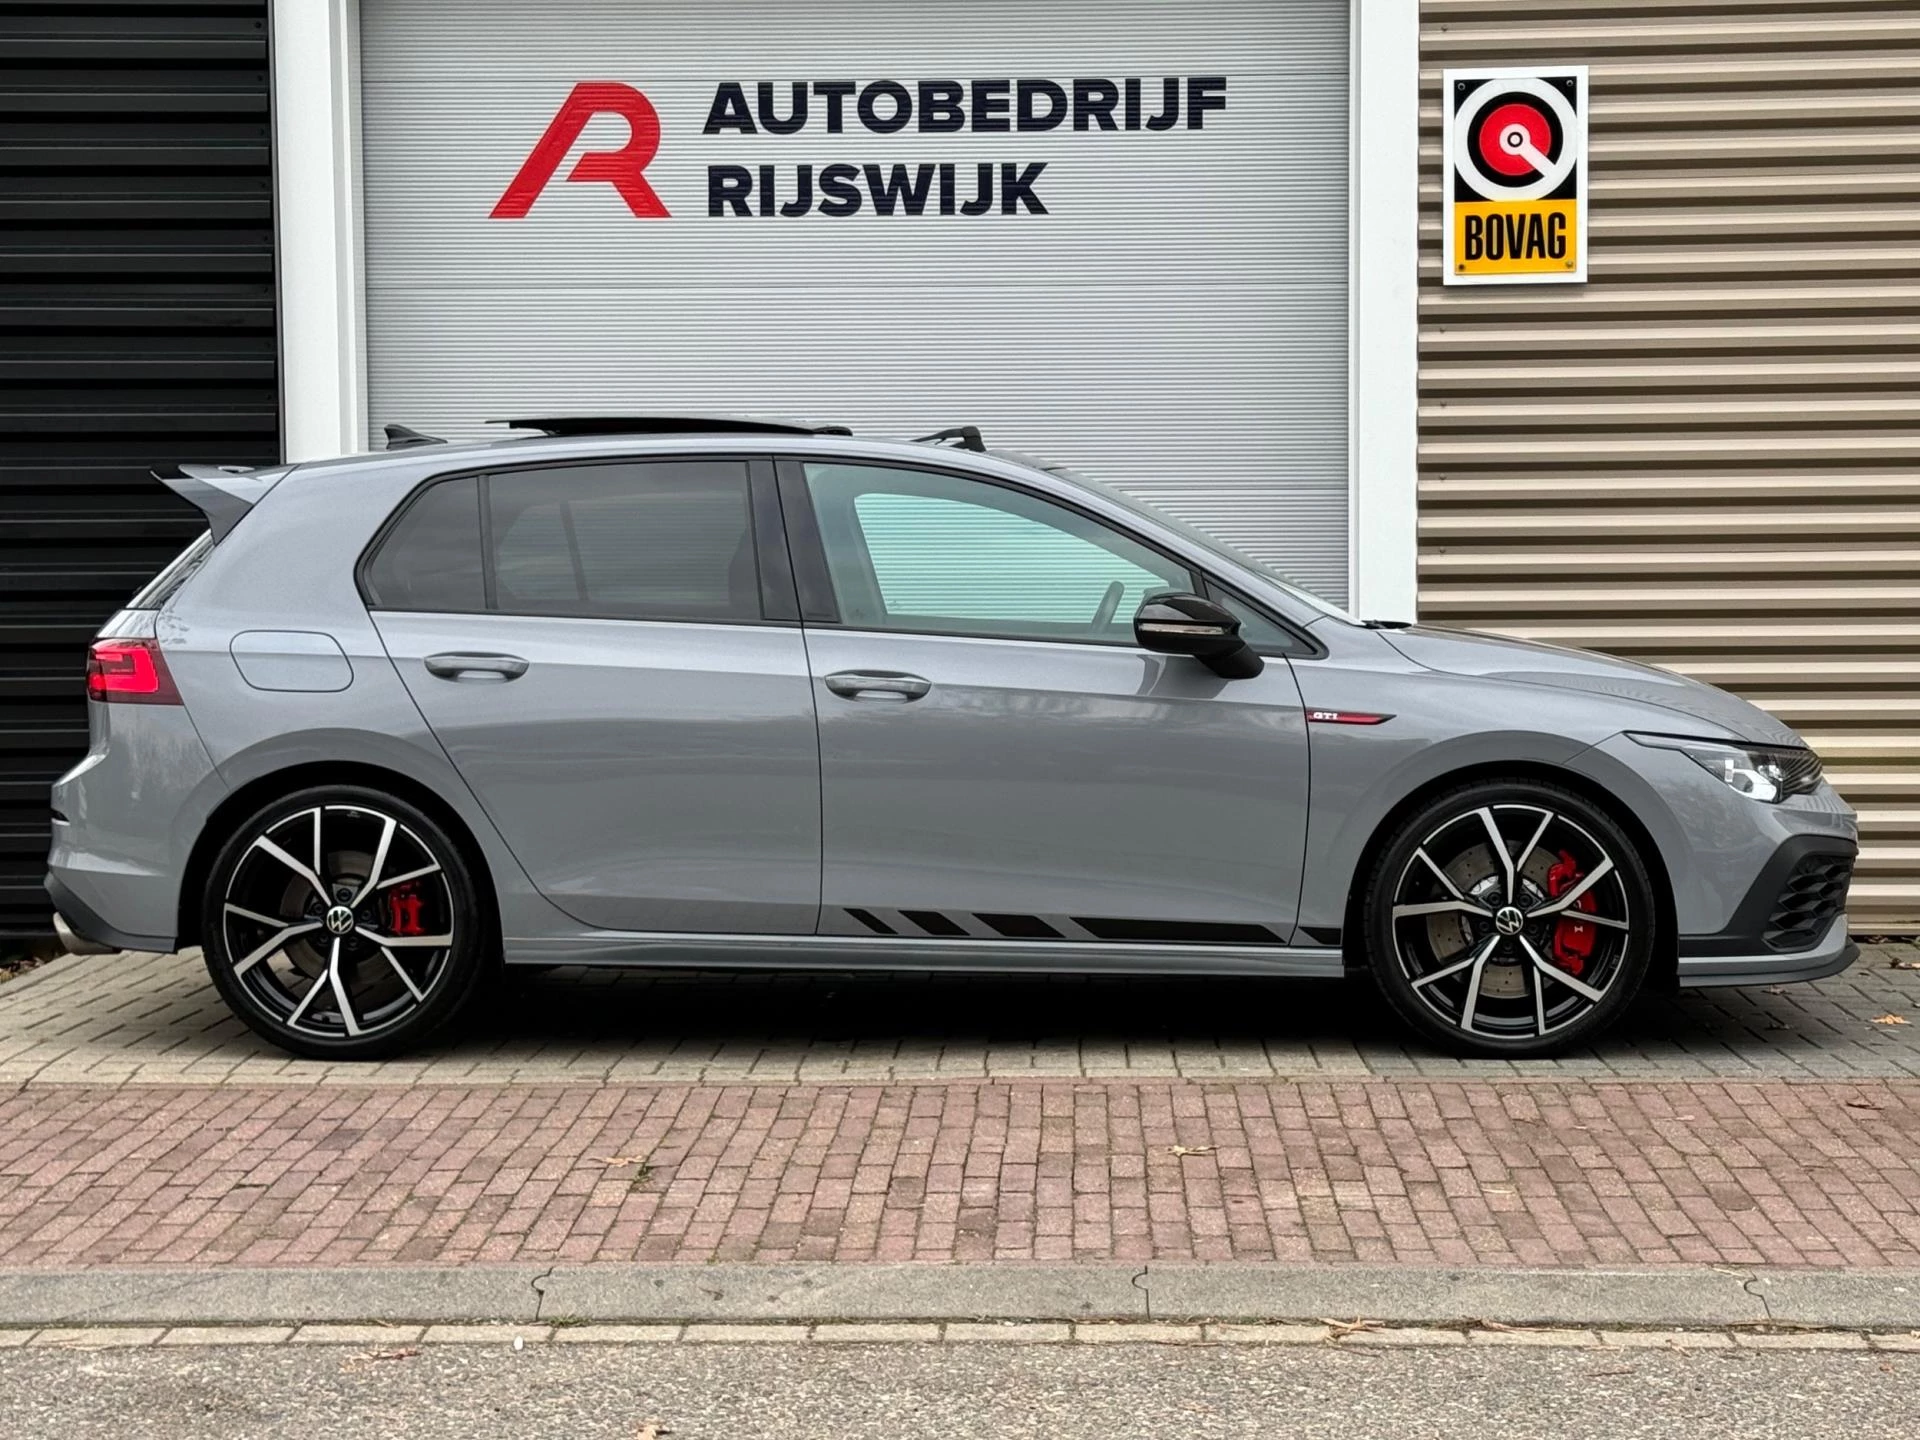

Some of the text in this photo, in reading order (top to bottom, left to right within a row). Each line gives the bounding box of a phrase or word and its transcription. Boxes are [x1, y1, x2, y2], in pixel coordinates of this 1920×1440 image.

[704, 77, 1226, 134] AUTOBEDRIJF
[707, 162, 1049, 218] RIJSWIJK
[1465, 213, 1566, 260] BOVAG
[1313, 711, 1338, 720] GTI
